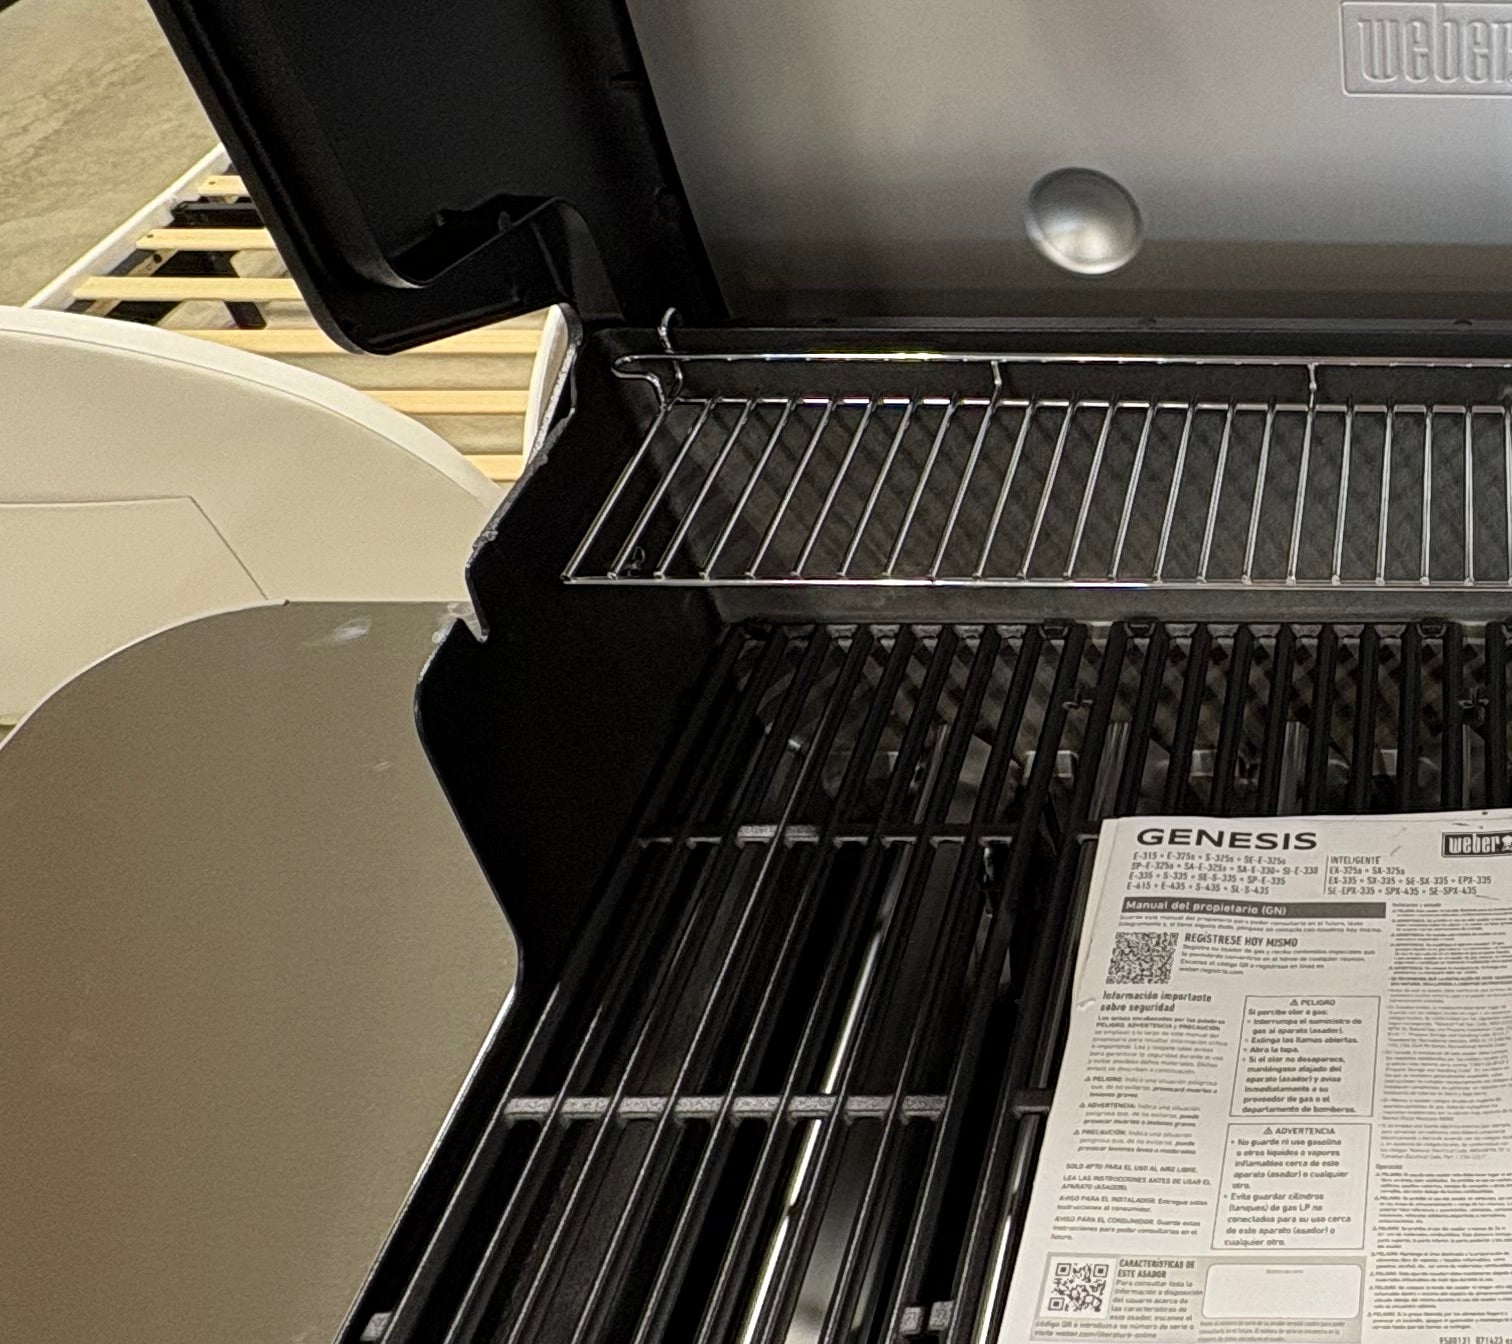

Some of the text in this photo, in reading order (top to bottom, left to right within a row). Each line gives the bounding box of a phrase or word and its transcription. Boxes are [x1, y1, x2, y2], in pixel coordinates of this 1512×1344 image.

[1136, 828, 1317, 850] GENESIS
[1448, 833, 1500, 854] weber
[1125, 901, 1287, 916] Manual del propietario (GN)
[1245, 935, 1264, 946] HOY
[1265, 936, 1298, 947] MISMO
[1102, 990, 1212, 1003] Información importante
[1100, 1003, 1175, 1014] sobre seguridad
[1275, 1127, 1335, 1135] ADVERTENCIA
[1117, 1270, 1135, 1278] ESTE
